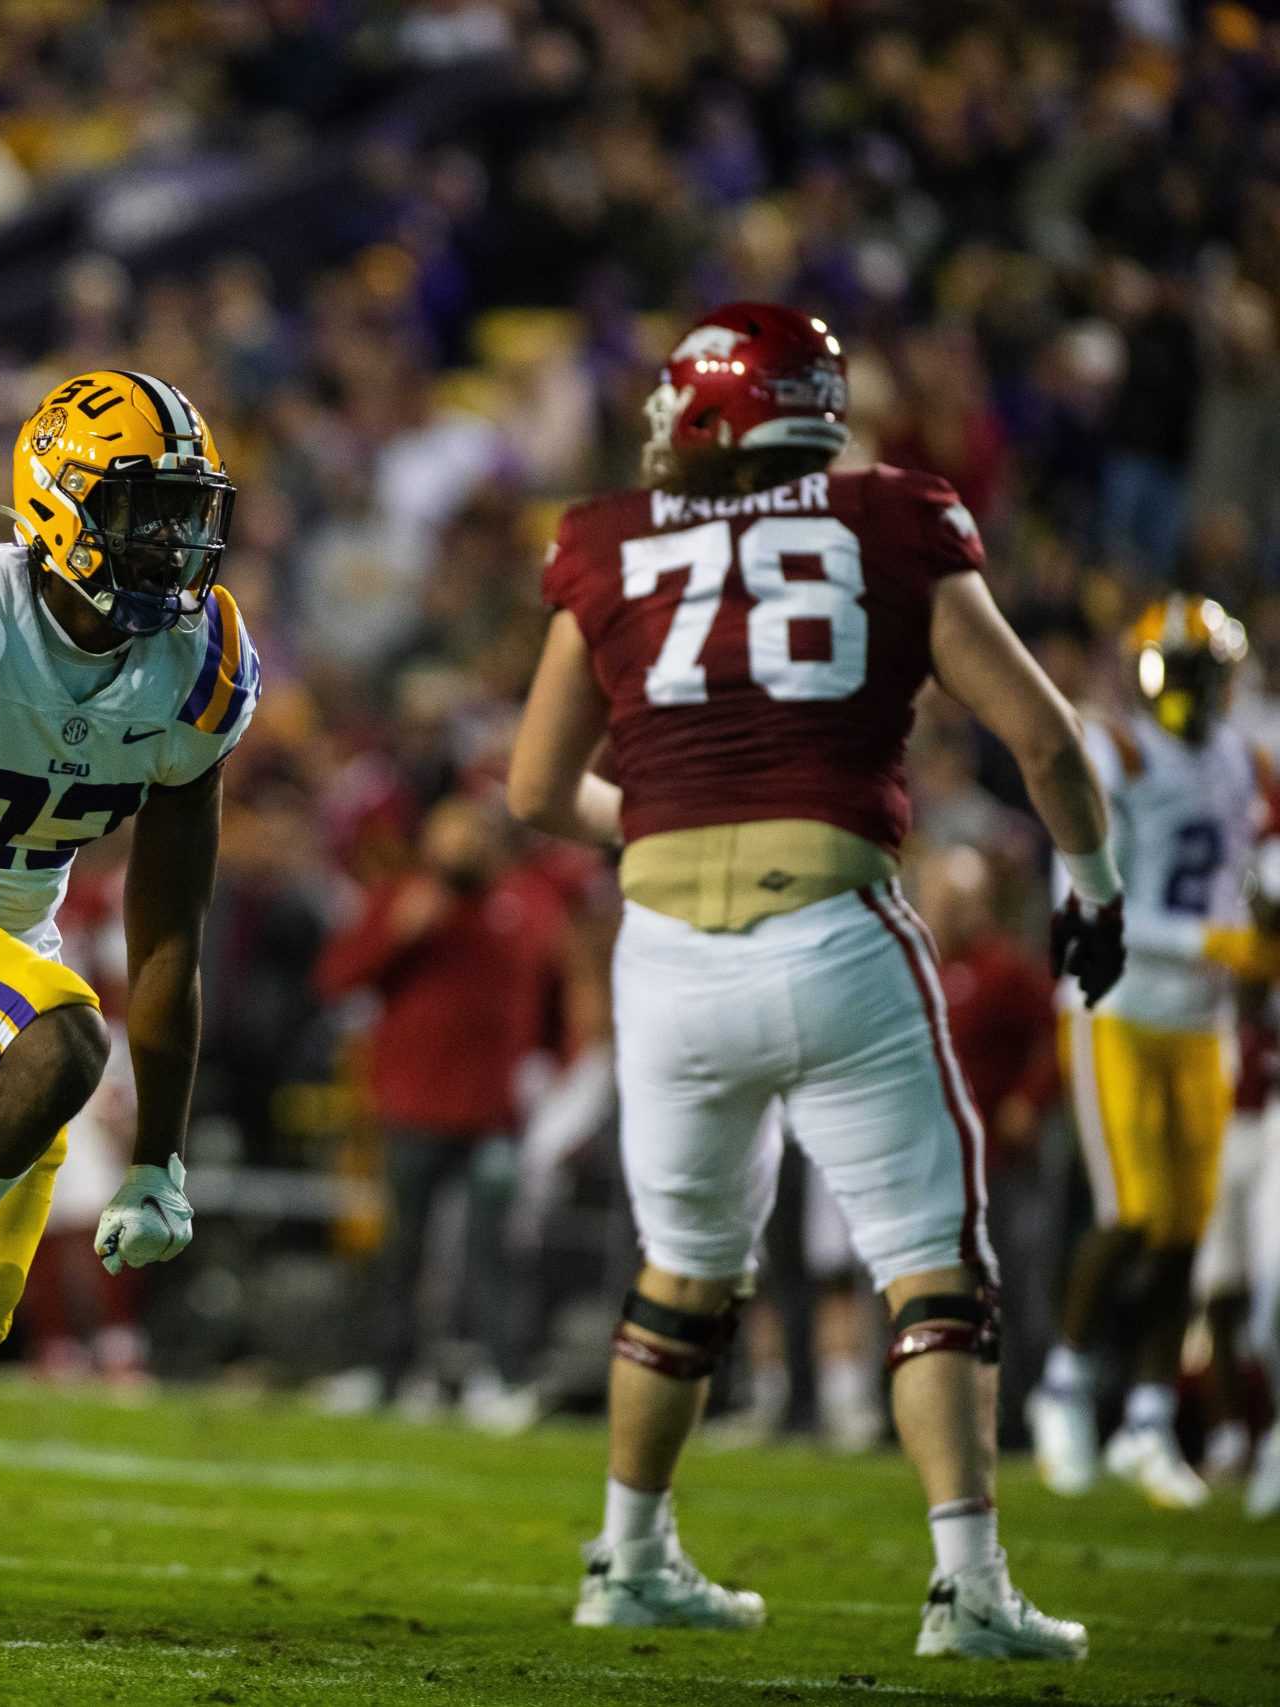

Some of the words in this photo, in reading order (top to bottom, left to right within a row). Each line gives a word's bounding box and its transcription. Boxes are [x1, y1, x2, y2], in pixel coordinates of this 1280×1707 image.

[621, 516, 868, 707] 78
[63, 718, 87, 743] SEC
[48, 759, 90, 777] LSU
[1165, 819, 1224, 917] 2
